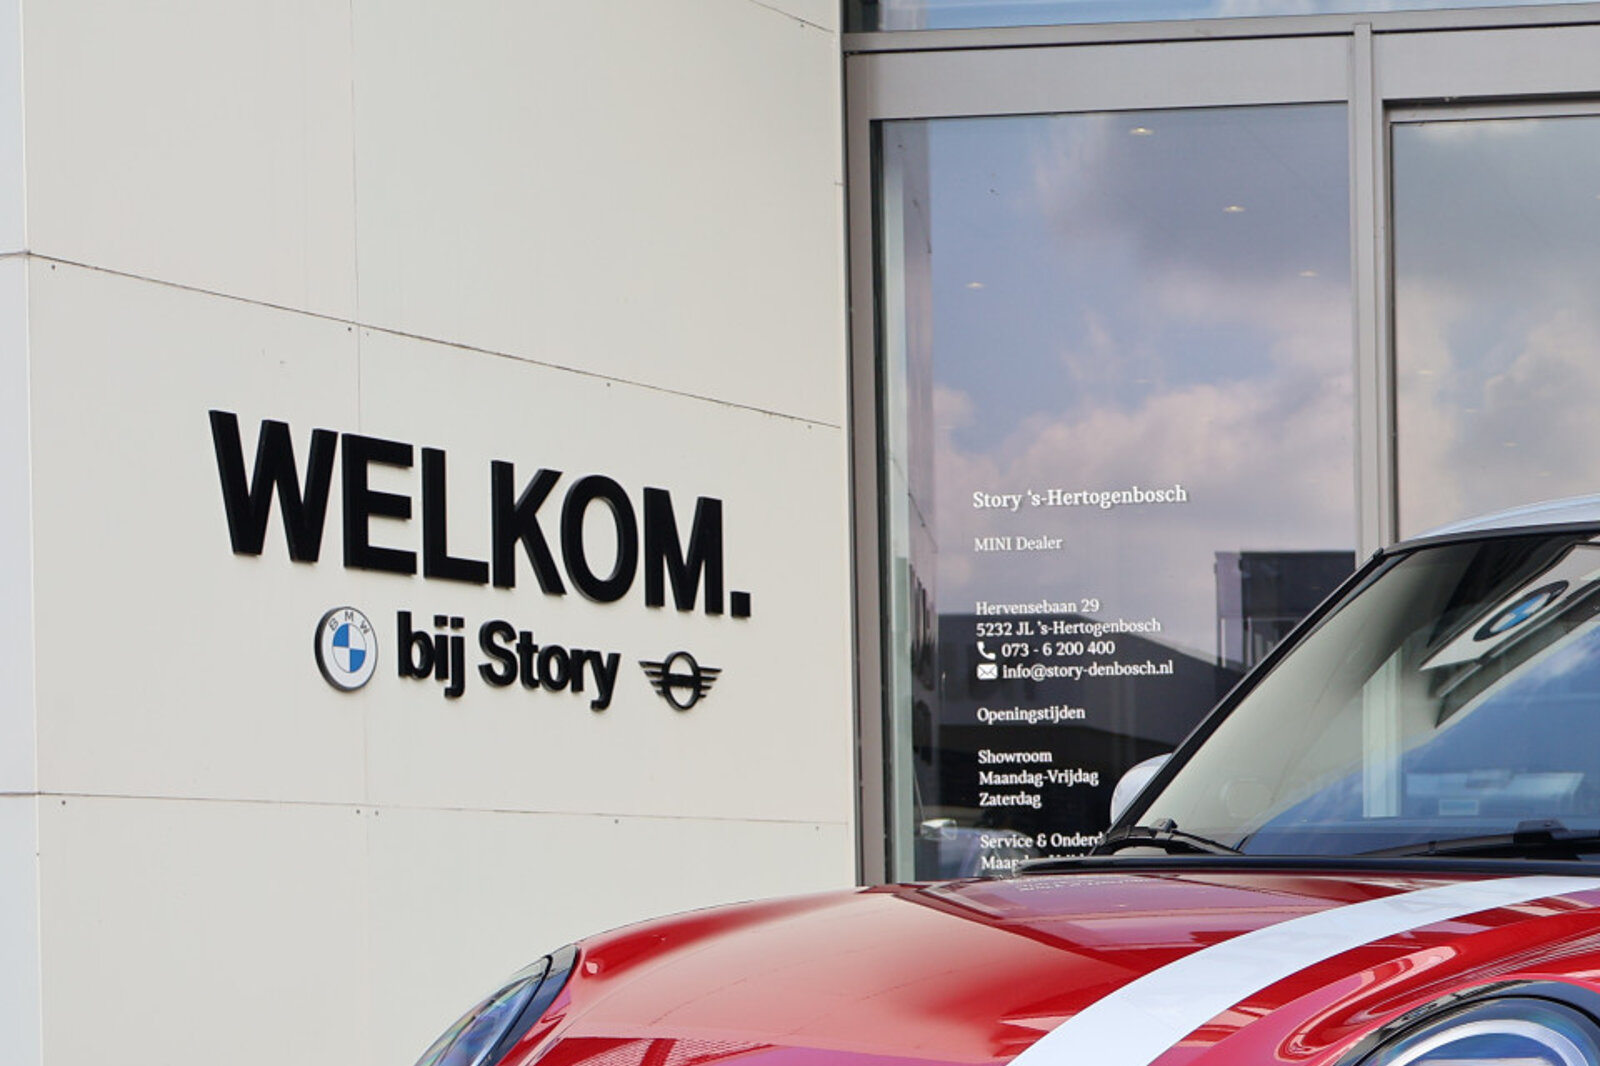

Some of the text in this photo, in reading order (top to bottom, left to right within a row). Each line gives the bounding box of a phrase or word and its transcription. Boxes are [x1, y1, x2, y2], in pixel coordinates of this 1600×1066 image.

[973, 490, 1023, 512] Story
[208, 409, 751, 618] WELKOM.
[974, 535, 1063, 552] MINI Dealer
[976, 598, 1100, 616] Hervensebaan 29
[976, 622, 1013, 637] 5232
[1016, 621, 1034, 636] JL
[1001, 642, 1030, 657] 073
[1042, 641, 1052, 656] 6
[1056, 641, 1084, 656] 200
[1087, 640, 1116, 656] 400
[397, 610, 621, 712] bij Story
[1003, 660, 1174, 682] info@story-denbosch.nl
[977, 705, 1086, 725] Openingstijden
[978, 750, 1052, 765] Showroom
[979, 769, 1099, 788] Maandag-Vrijdag
[979, 792, 1042, 809] Zaterdag
[980, 833, 1033, 849] Service
[1036, 832, 1047, 848] &
